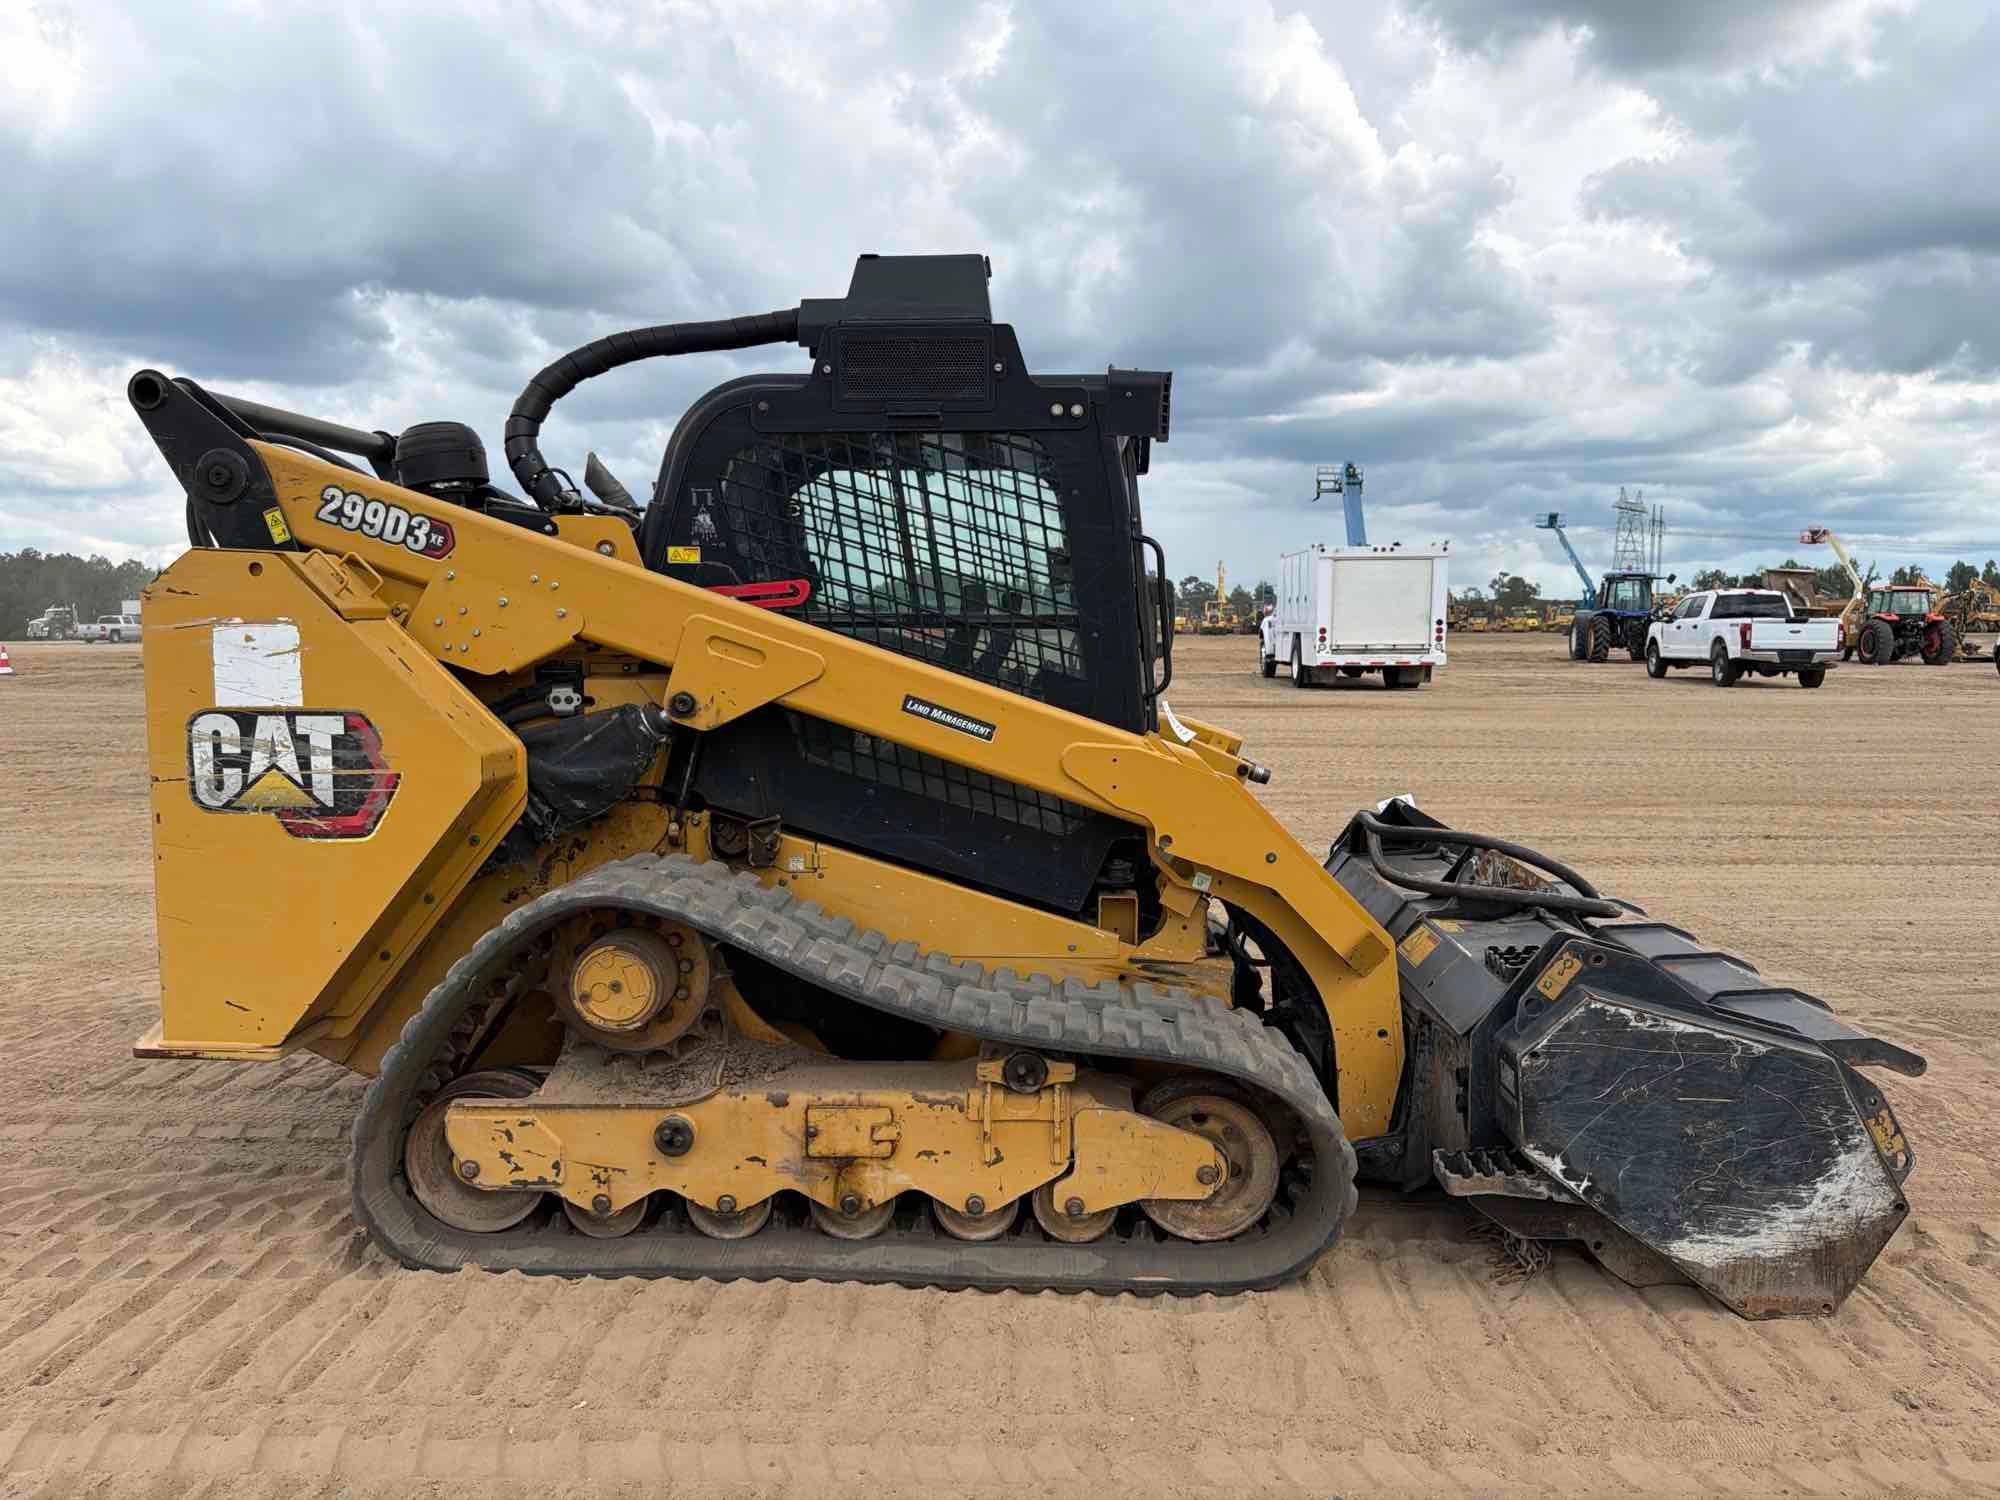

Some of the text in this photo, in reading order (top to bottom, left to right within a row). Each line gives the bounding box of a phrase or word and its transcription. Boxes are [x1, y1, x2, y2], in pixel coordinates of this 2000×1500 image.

[317, 485, 431, 551] 299D3
[906, 699, 992, 736] LAND MANAGEMENT
[191, 713, 345, 808] CAT
